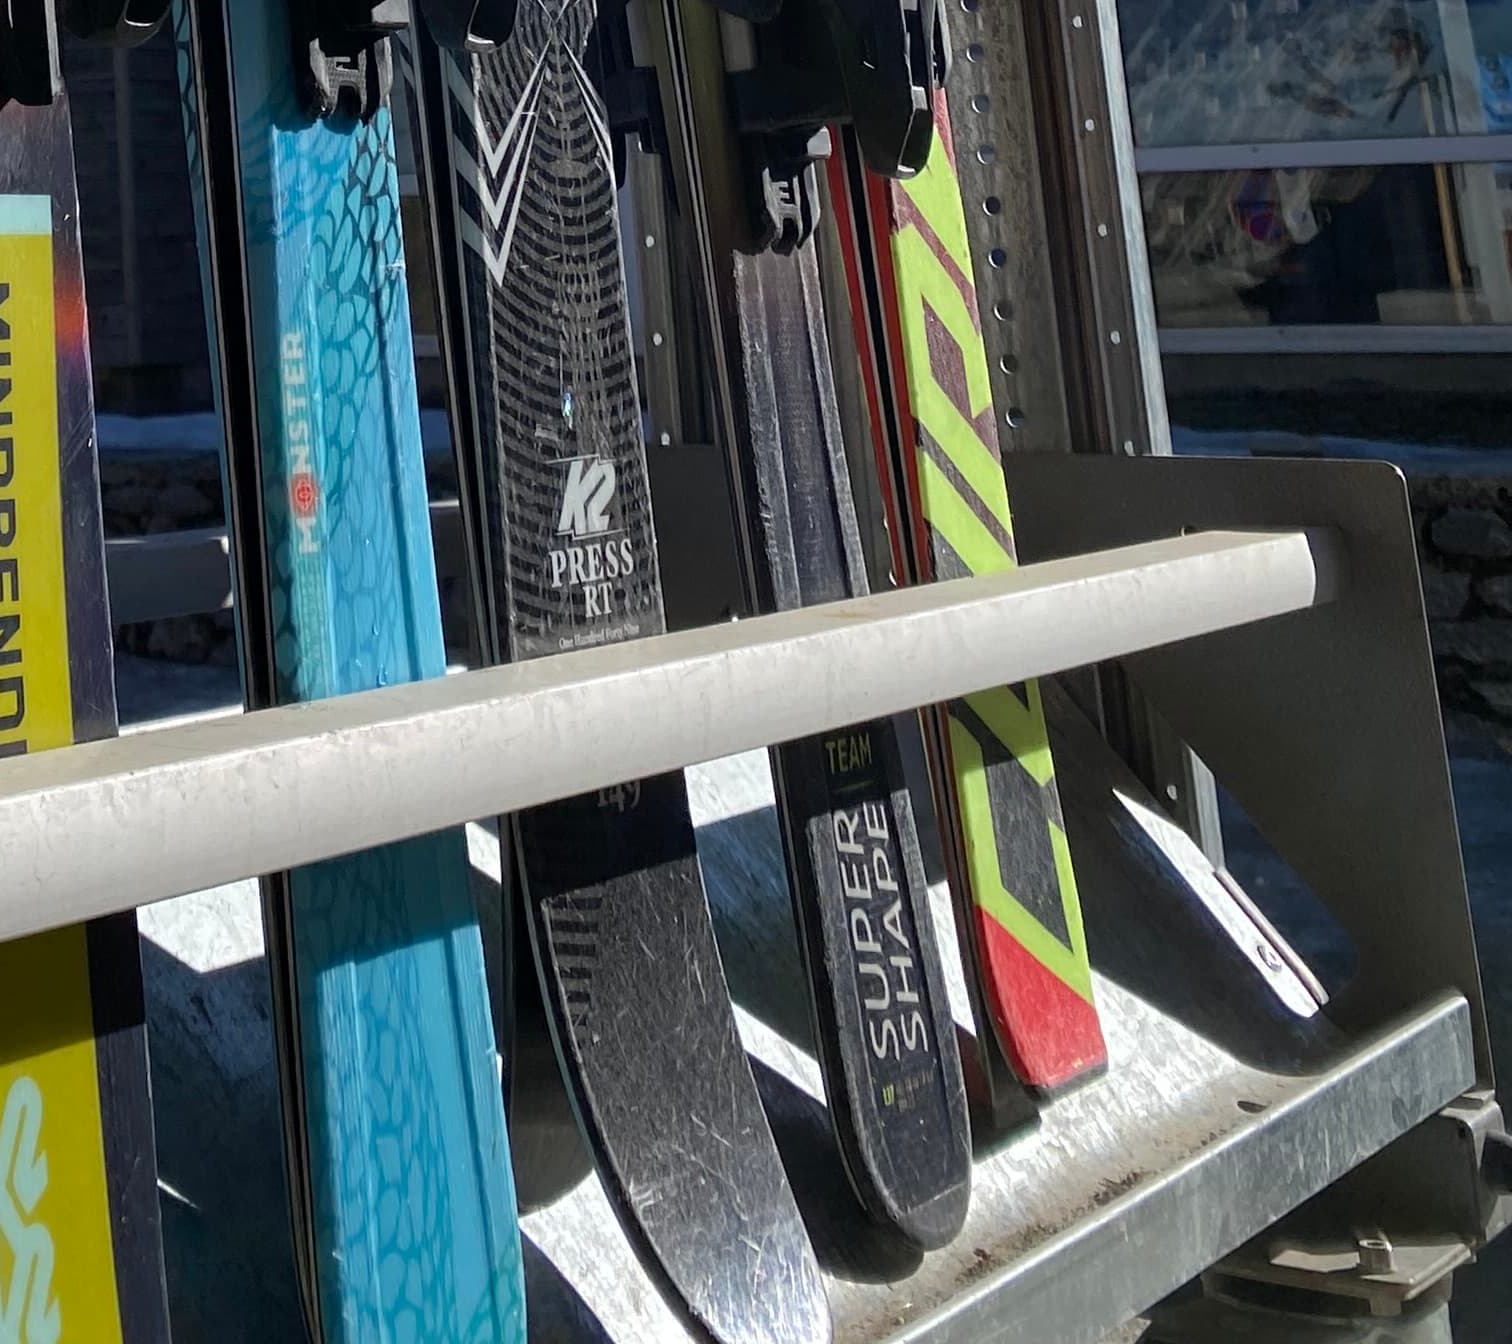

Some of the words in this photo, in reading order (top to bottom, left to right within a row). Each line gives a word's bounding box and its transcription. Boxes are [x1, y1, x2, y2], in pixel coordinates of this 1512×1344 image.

[558, 458, 616, 536] K2
[549, 538, 634, 588] PRESS
[583, 582, 613, 618] RT
[559, 636, 574, 650] One
[574, 631, 605, 647] Hundred
[825, 733, 873, 775] TEAM
[834, 809, 900, 1062] SUPER
[863, 801, 929, 1054] SHAPE
